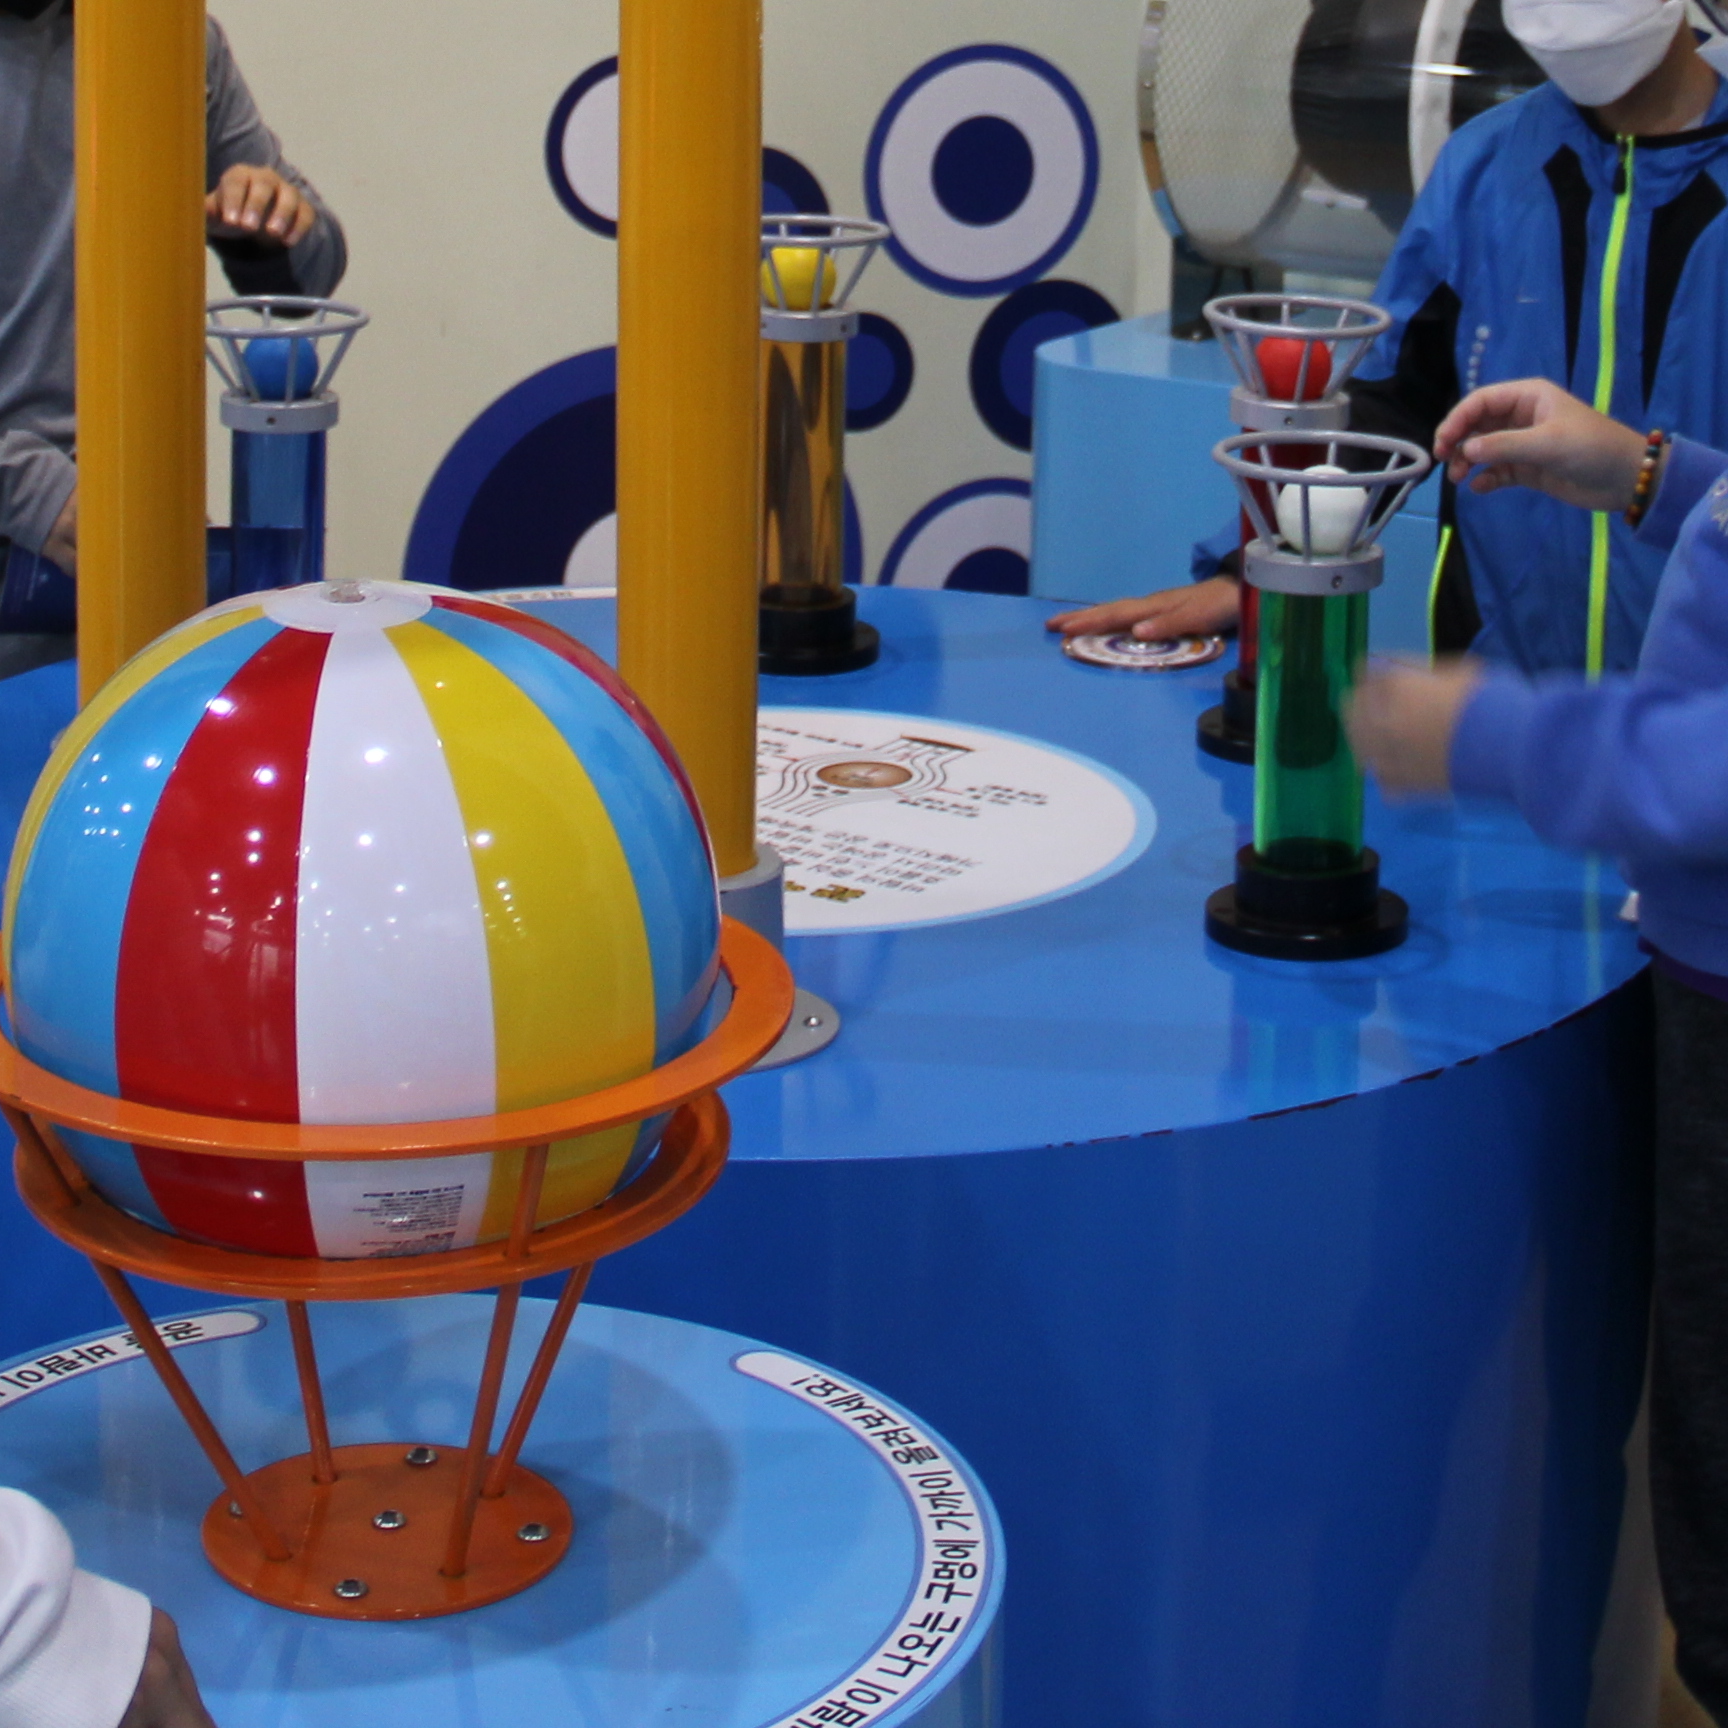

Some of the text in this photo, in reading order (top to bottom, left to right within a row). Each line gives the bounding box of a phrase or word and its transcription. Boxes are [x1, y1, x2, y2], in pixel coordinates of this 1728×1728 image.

[0, 1344, 118, 1390] 바람이
[790, 1374, 940, 1465] 올려보세요!
[908, 1469, 975, 1531] 가까이
[923, 1539, 981, 1605] 구멍에
[876, 1611, 963, 1680] 나오는
